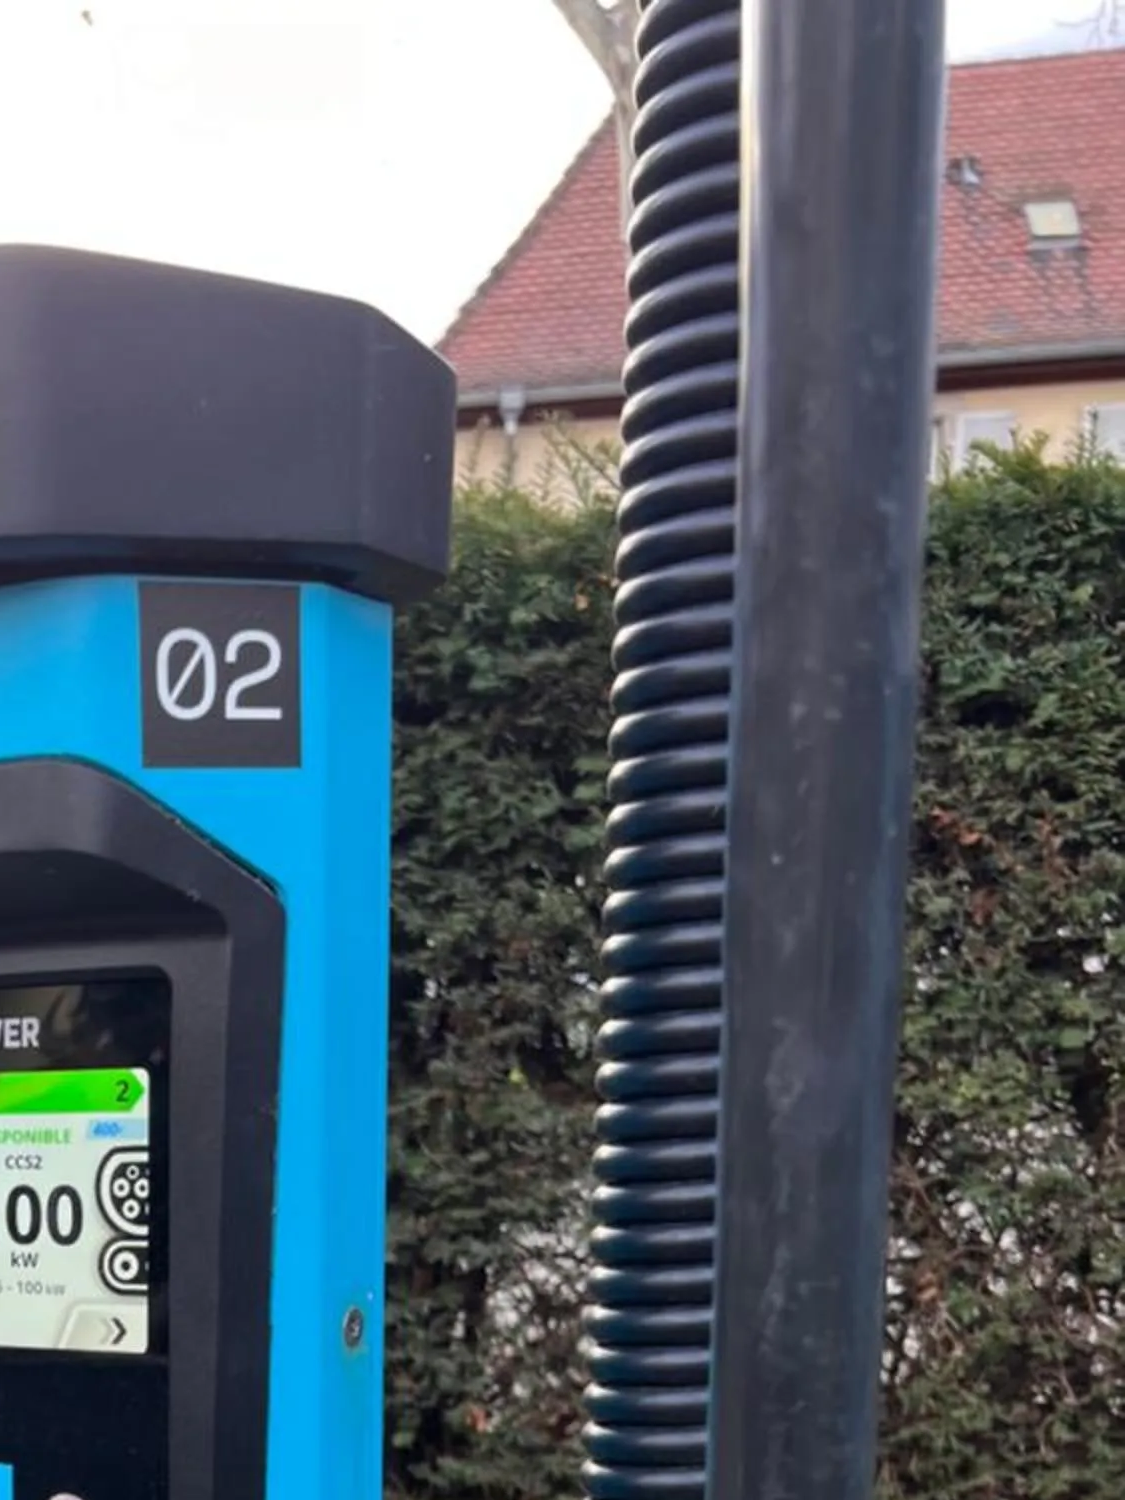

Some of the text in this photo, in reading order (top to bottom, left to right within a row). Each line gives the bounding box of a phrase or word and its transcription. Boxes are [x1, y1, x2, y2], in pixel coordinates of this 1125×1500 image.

[155, 626, 283, 721] 02
[115, 1079, 130, 1102] 2
[4, 1154, 43, 1170] CCS2
[10, 1252, 39, 1268] kW
[16, 1280, 44, 1296] 100
